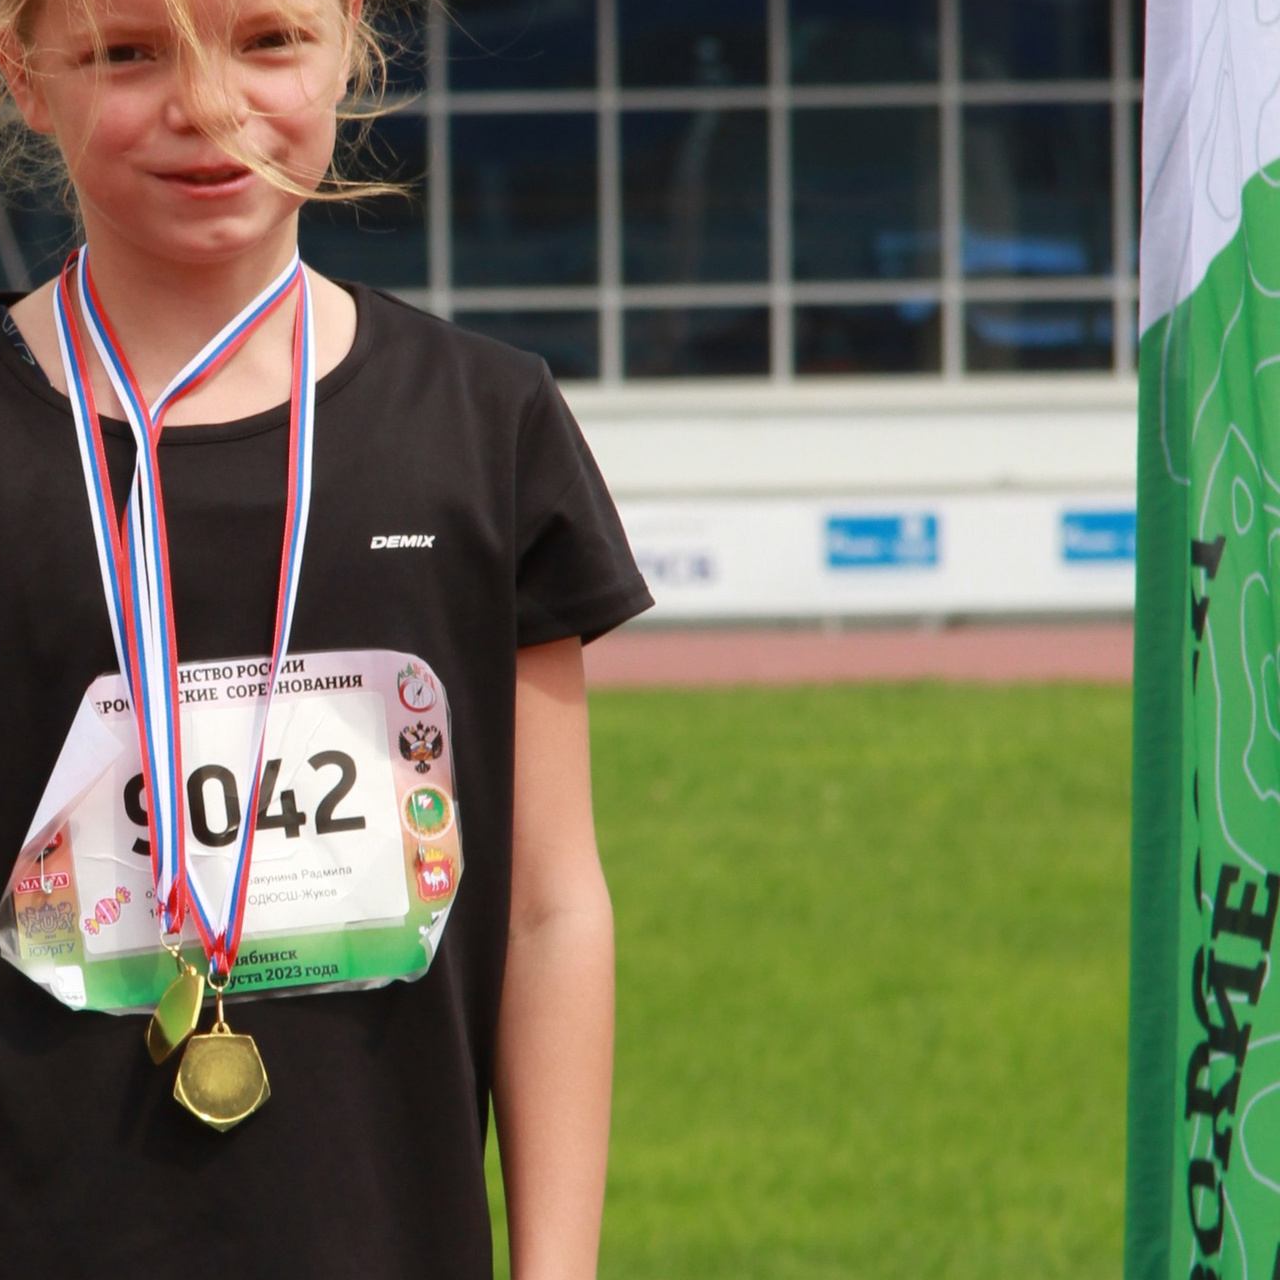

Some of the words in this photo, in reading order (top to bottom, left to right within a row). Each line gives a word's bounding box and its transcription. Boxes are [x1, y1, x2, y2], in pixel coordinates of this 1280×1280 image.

[370, 535, 435, 549] DEMIX
[179, 666, 233, 684] НСТВО
[235, 948, 297, 967] ябинск
[265, 966, 302, 981] 2023
[305, 963, 339, 978] года
